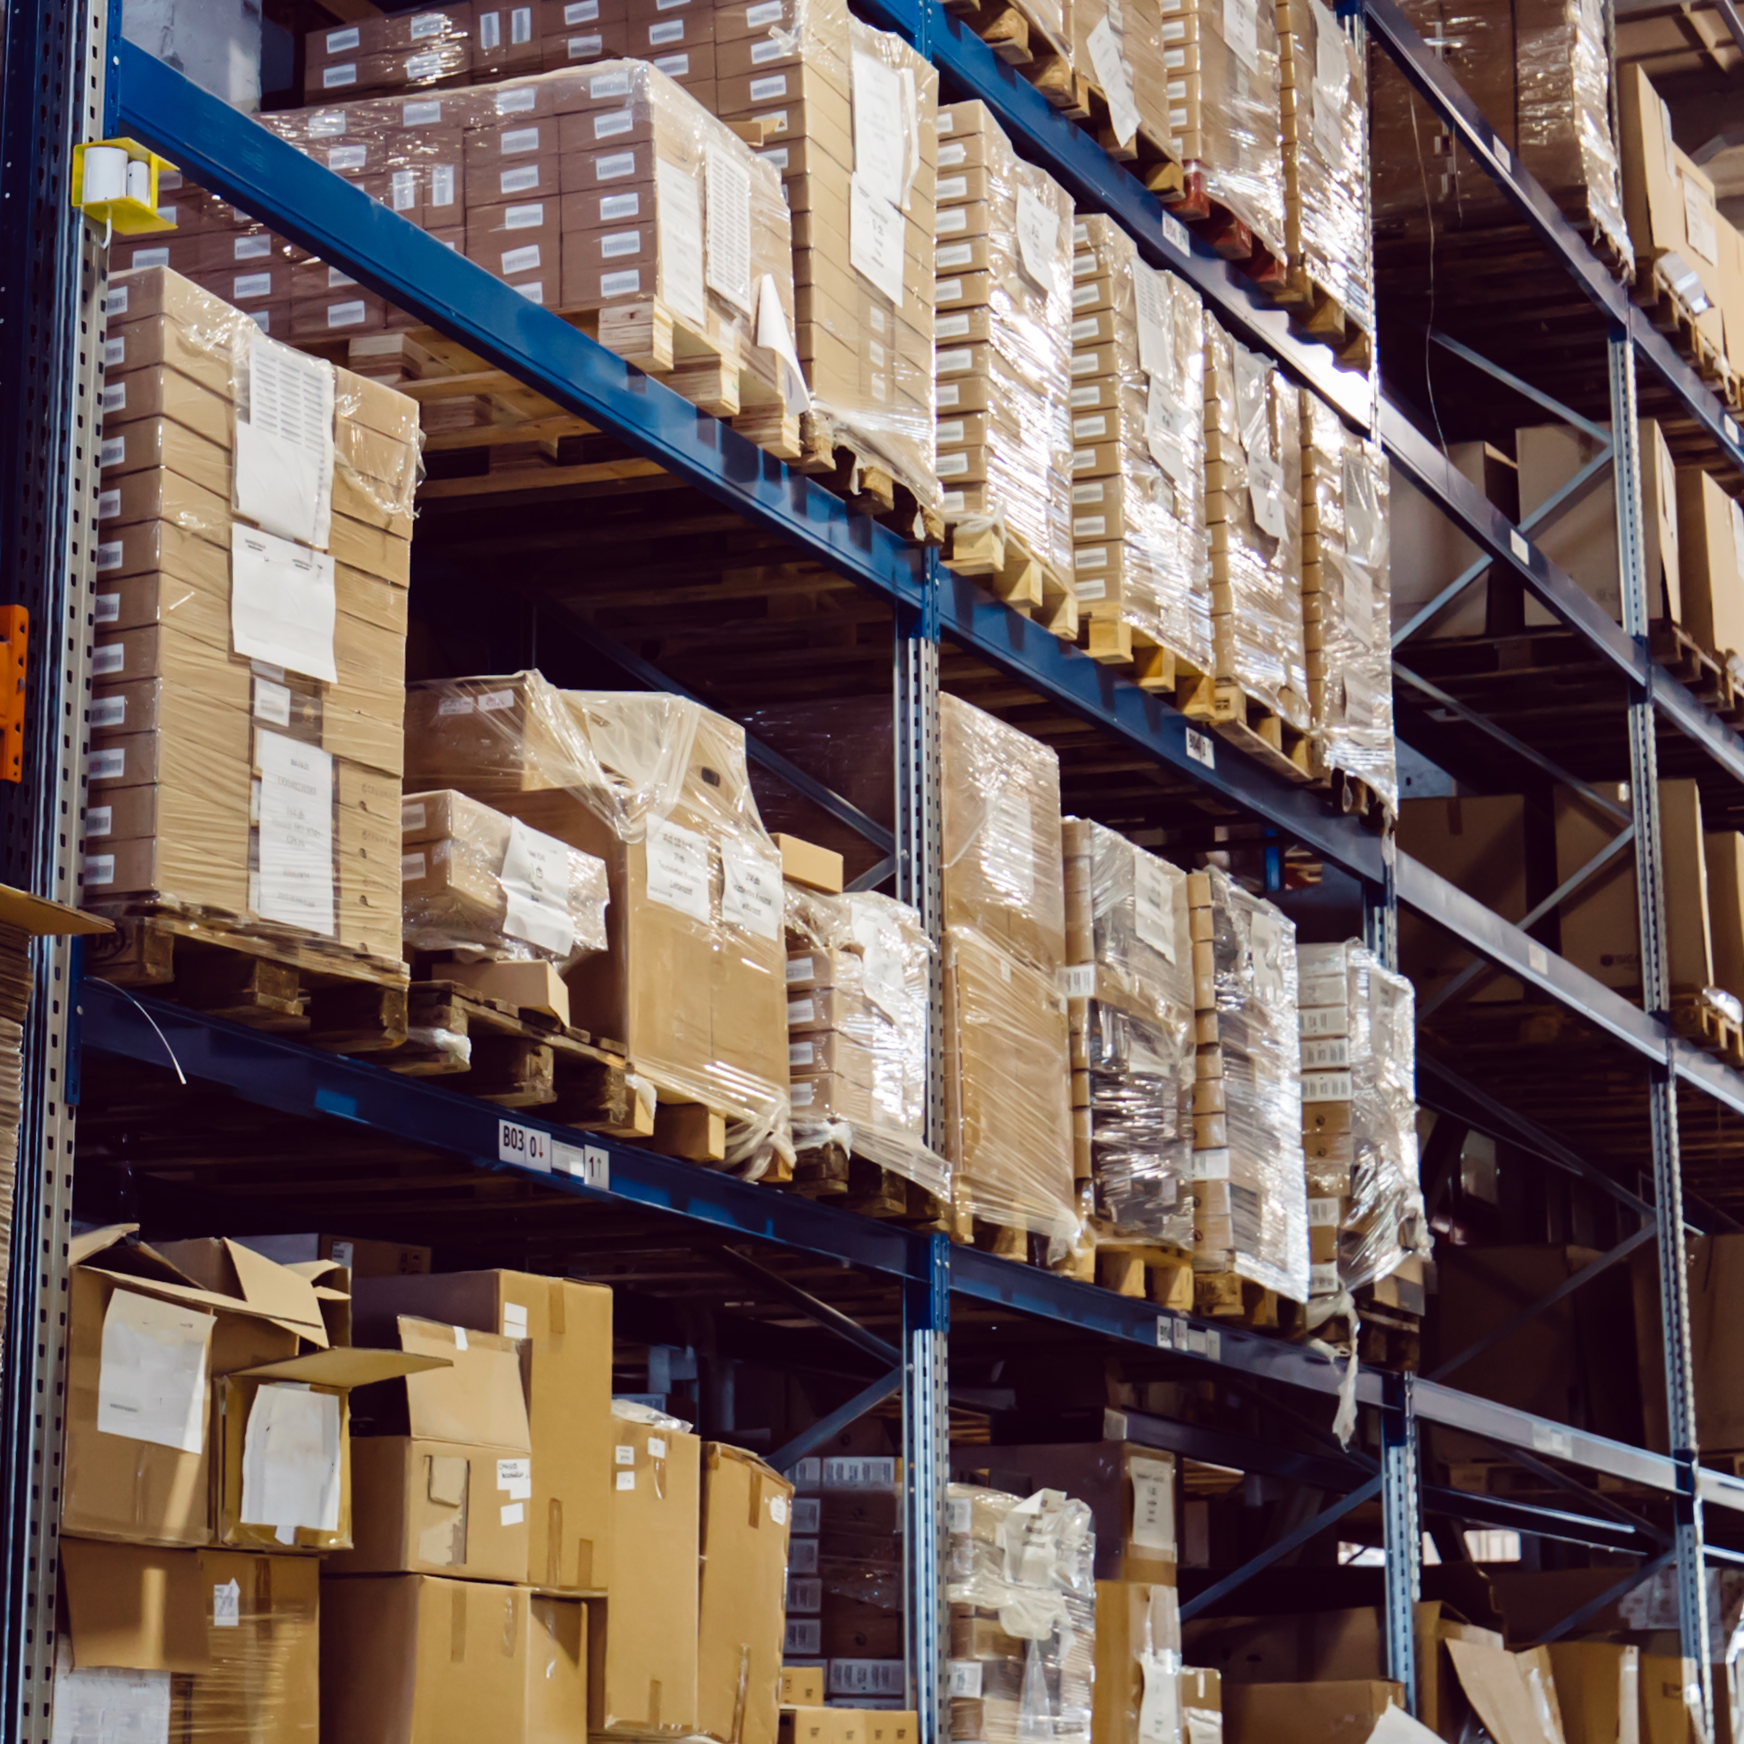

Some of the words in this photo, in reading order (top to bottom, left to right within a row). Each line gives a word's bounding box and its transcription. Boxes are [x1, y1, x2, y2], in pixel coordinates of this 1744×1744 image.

[503, 1125, 524, 1151] B03
[529, 1136, 537, 1158] 0
[589, 1156, 594, 1177] 1
